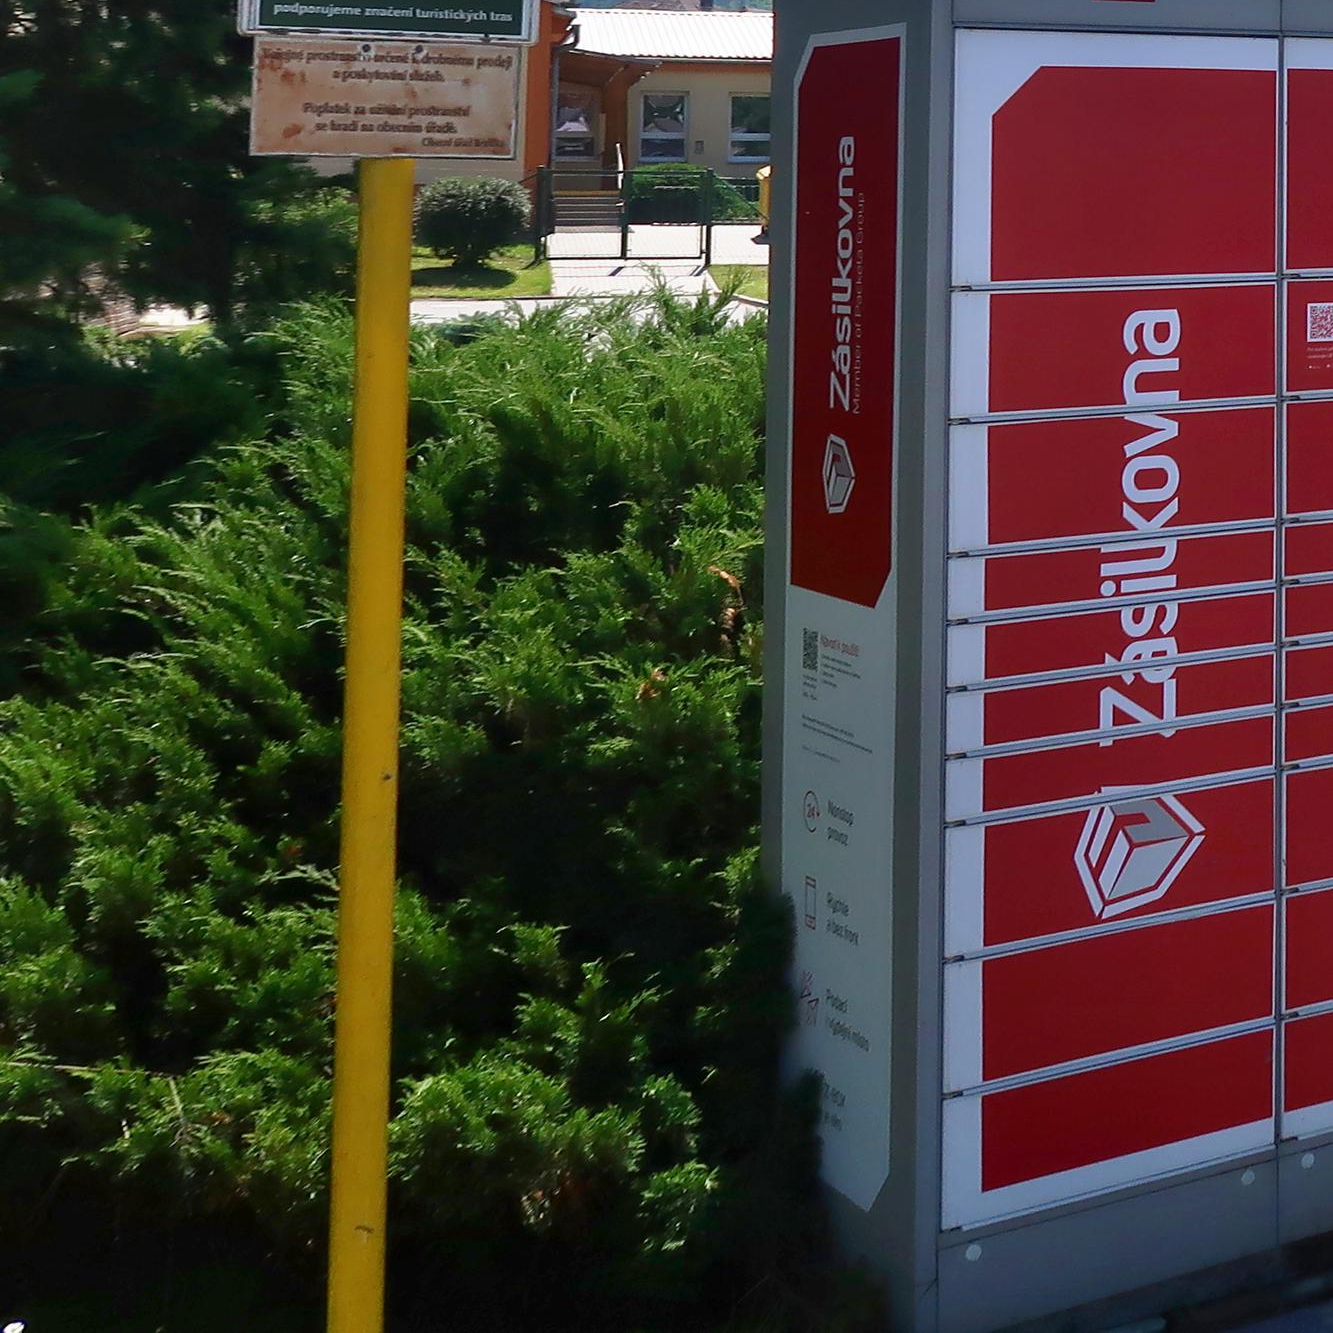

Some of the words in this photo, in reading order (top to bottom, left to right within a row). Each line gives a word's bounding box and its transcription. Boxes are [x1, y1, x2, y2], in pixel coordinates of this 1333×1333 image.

[274, 3, 361, 17] podporujeme
[365, 6, 413, 18] značení
[416, 8, 487, 23] turistických
[491, 12, 512, 22] tras
[303, 102, 351, 117] Poplatek
[856, 192, 865, 244] Group
[830, 136, 854, 411] Zásilkovna
[855, 249, 863, 317] Packeta
[855, 323, 862, 339] of
[852, 345, 862, 415] Member
[1099, 308, 1181, 747] Zásilkovna
